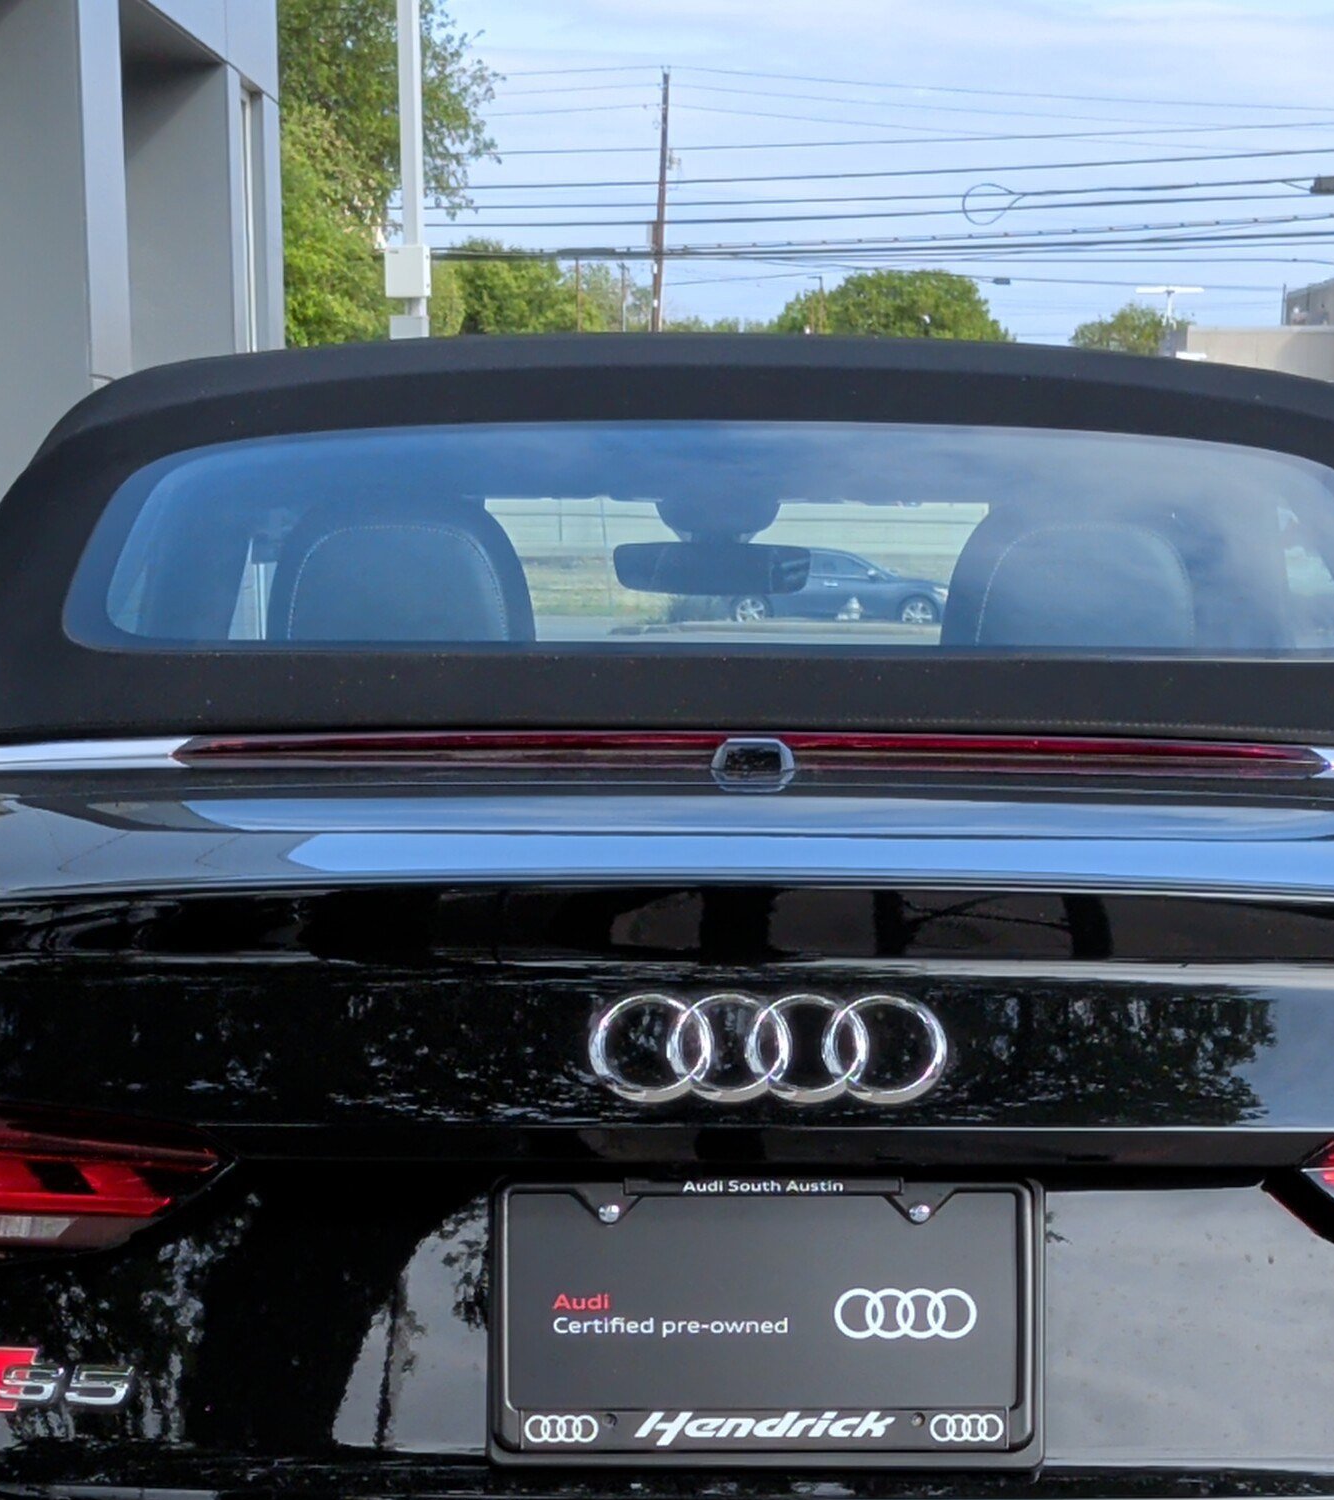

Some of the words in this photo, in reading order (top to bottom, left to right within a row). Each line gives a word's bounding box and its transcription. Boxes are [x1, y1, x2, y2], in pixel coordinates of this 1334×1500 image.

[682, 1180, 724, 1193] Audi
[727, 1180, 781, 1193] South
[785, 1180, 844, 1193] Austin
[552, 1292, 610, 1311] Audi
[552, 1316, 655, 1335] Certified
[661, 1317, 789, 1338] pre-owned
[634, 1411, 896, 1446] Hendrick
